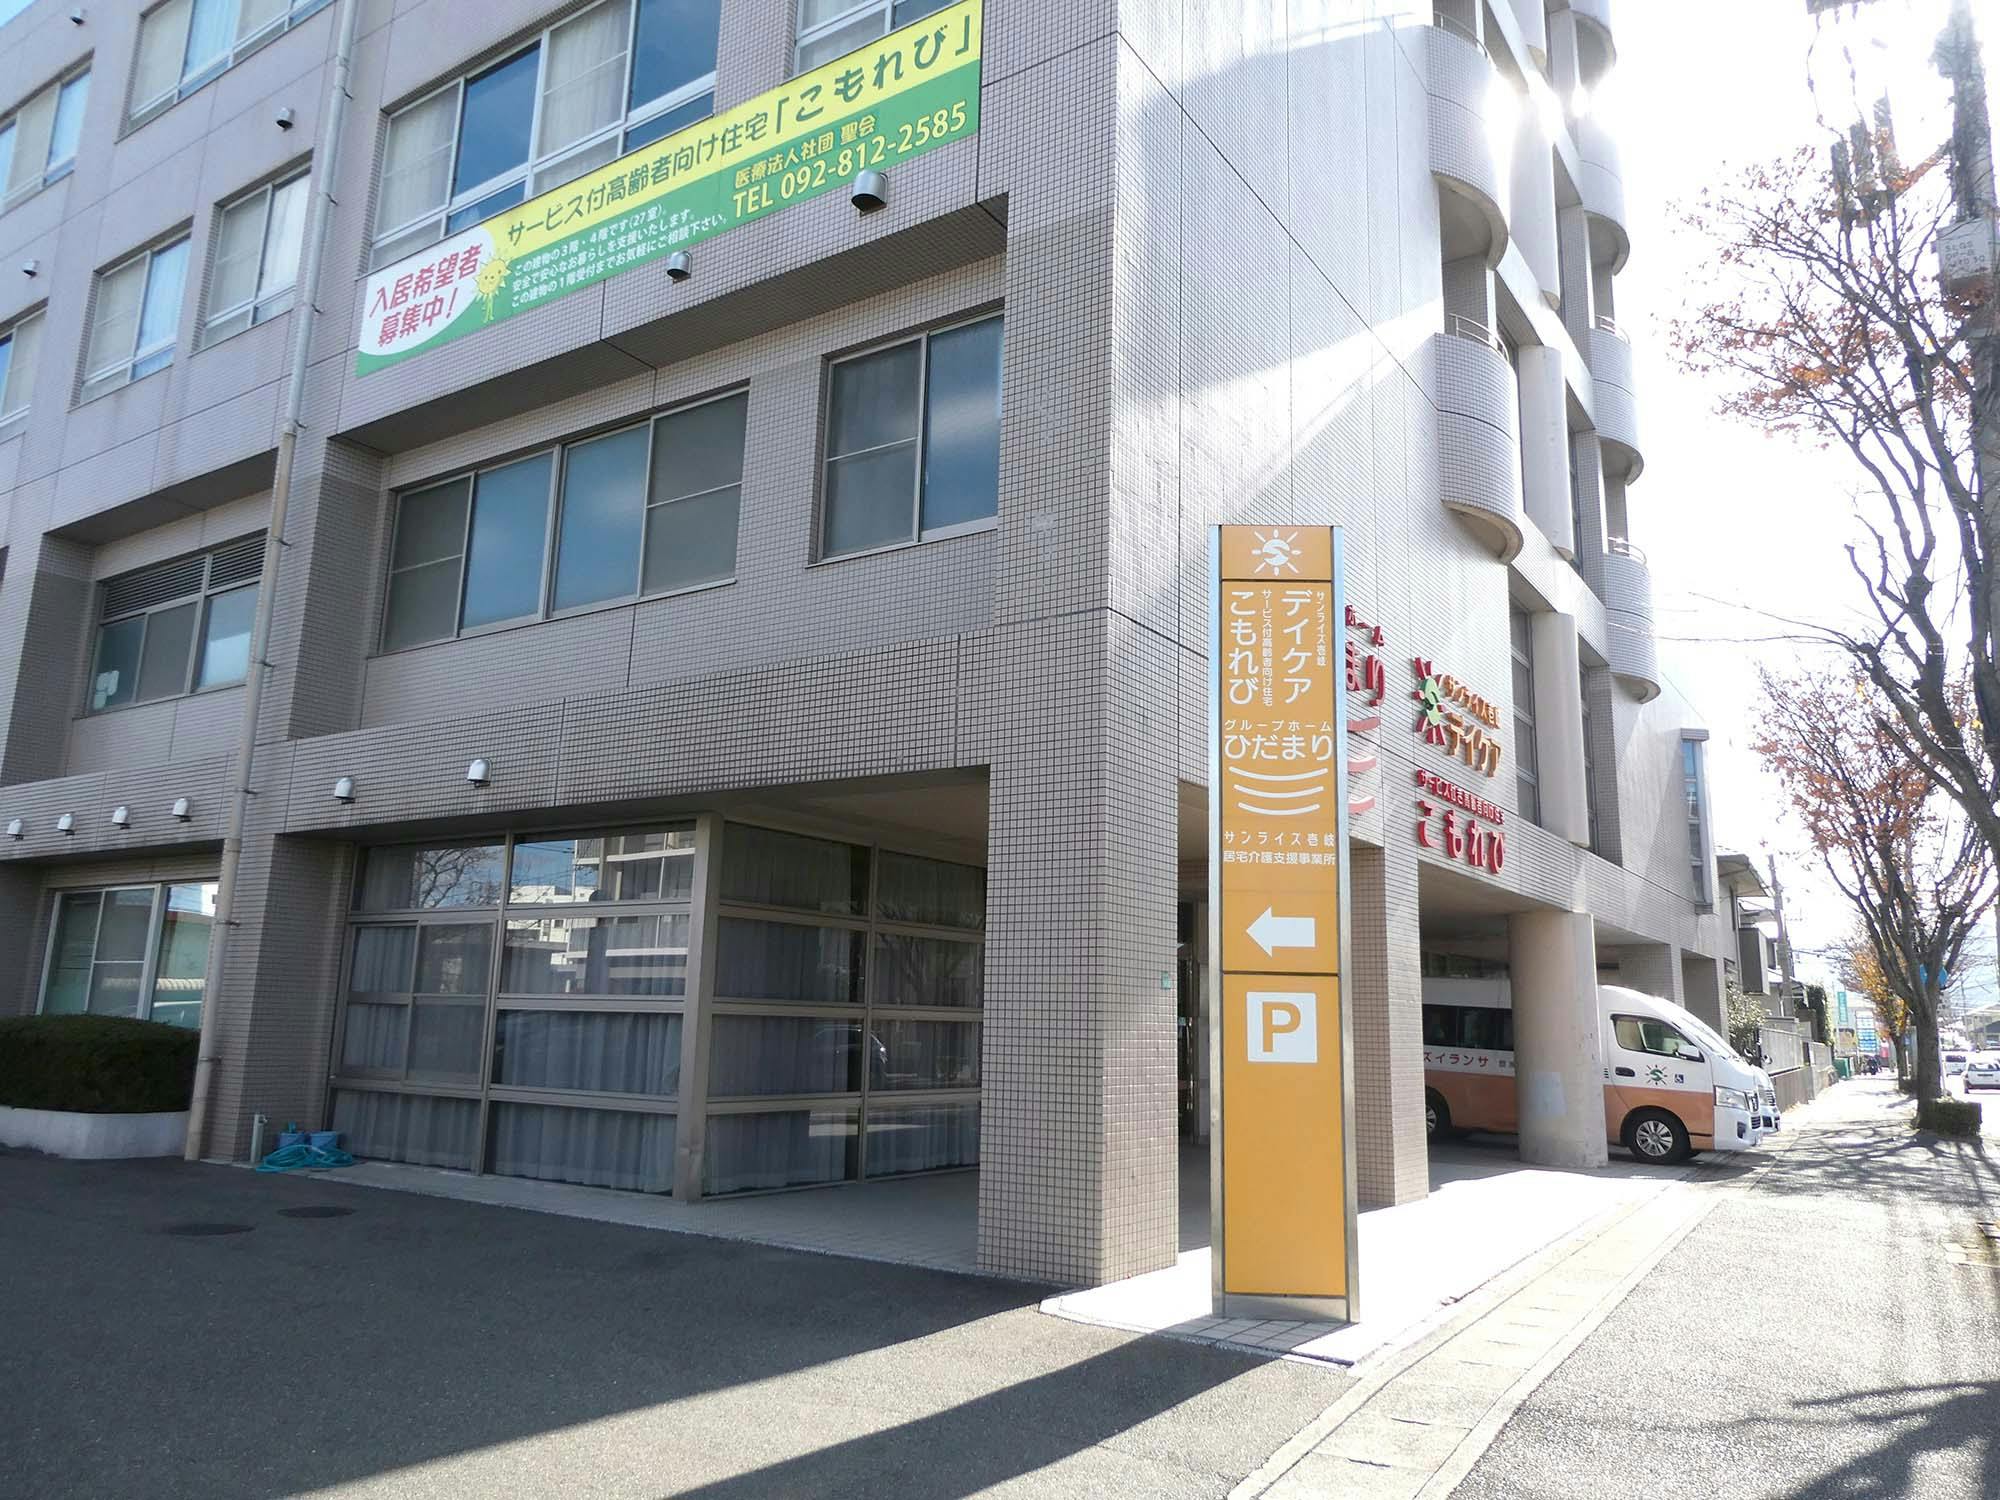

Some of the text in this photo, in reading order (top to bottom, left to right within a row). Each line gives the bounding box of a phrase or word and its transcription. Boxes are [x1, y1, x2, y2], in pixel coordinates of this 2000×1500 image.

[733, 100, 967, 218] TEL 092-812-2585
[735, 115, 877, 189] 医療法人社団 聖会
[369, 244, 483, 318] 入居希望者
[1228, 590, 1260, 705] こもれび
[1281, 589, 1313, 704] デイケア
[1224, 719, 1332, 732] グループホーム
[1224, 733, 1334, 761] ひだまり
[1222, 850, 1336, 866] 居宅介護支援事業所
[1223, 830, 1336, 848] サンライズ壱岐
[1263, 1001, 1301, 1053] P
